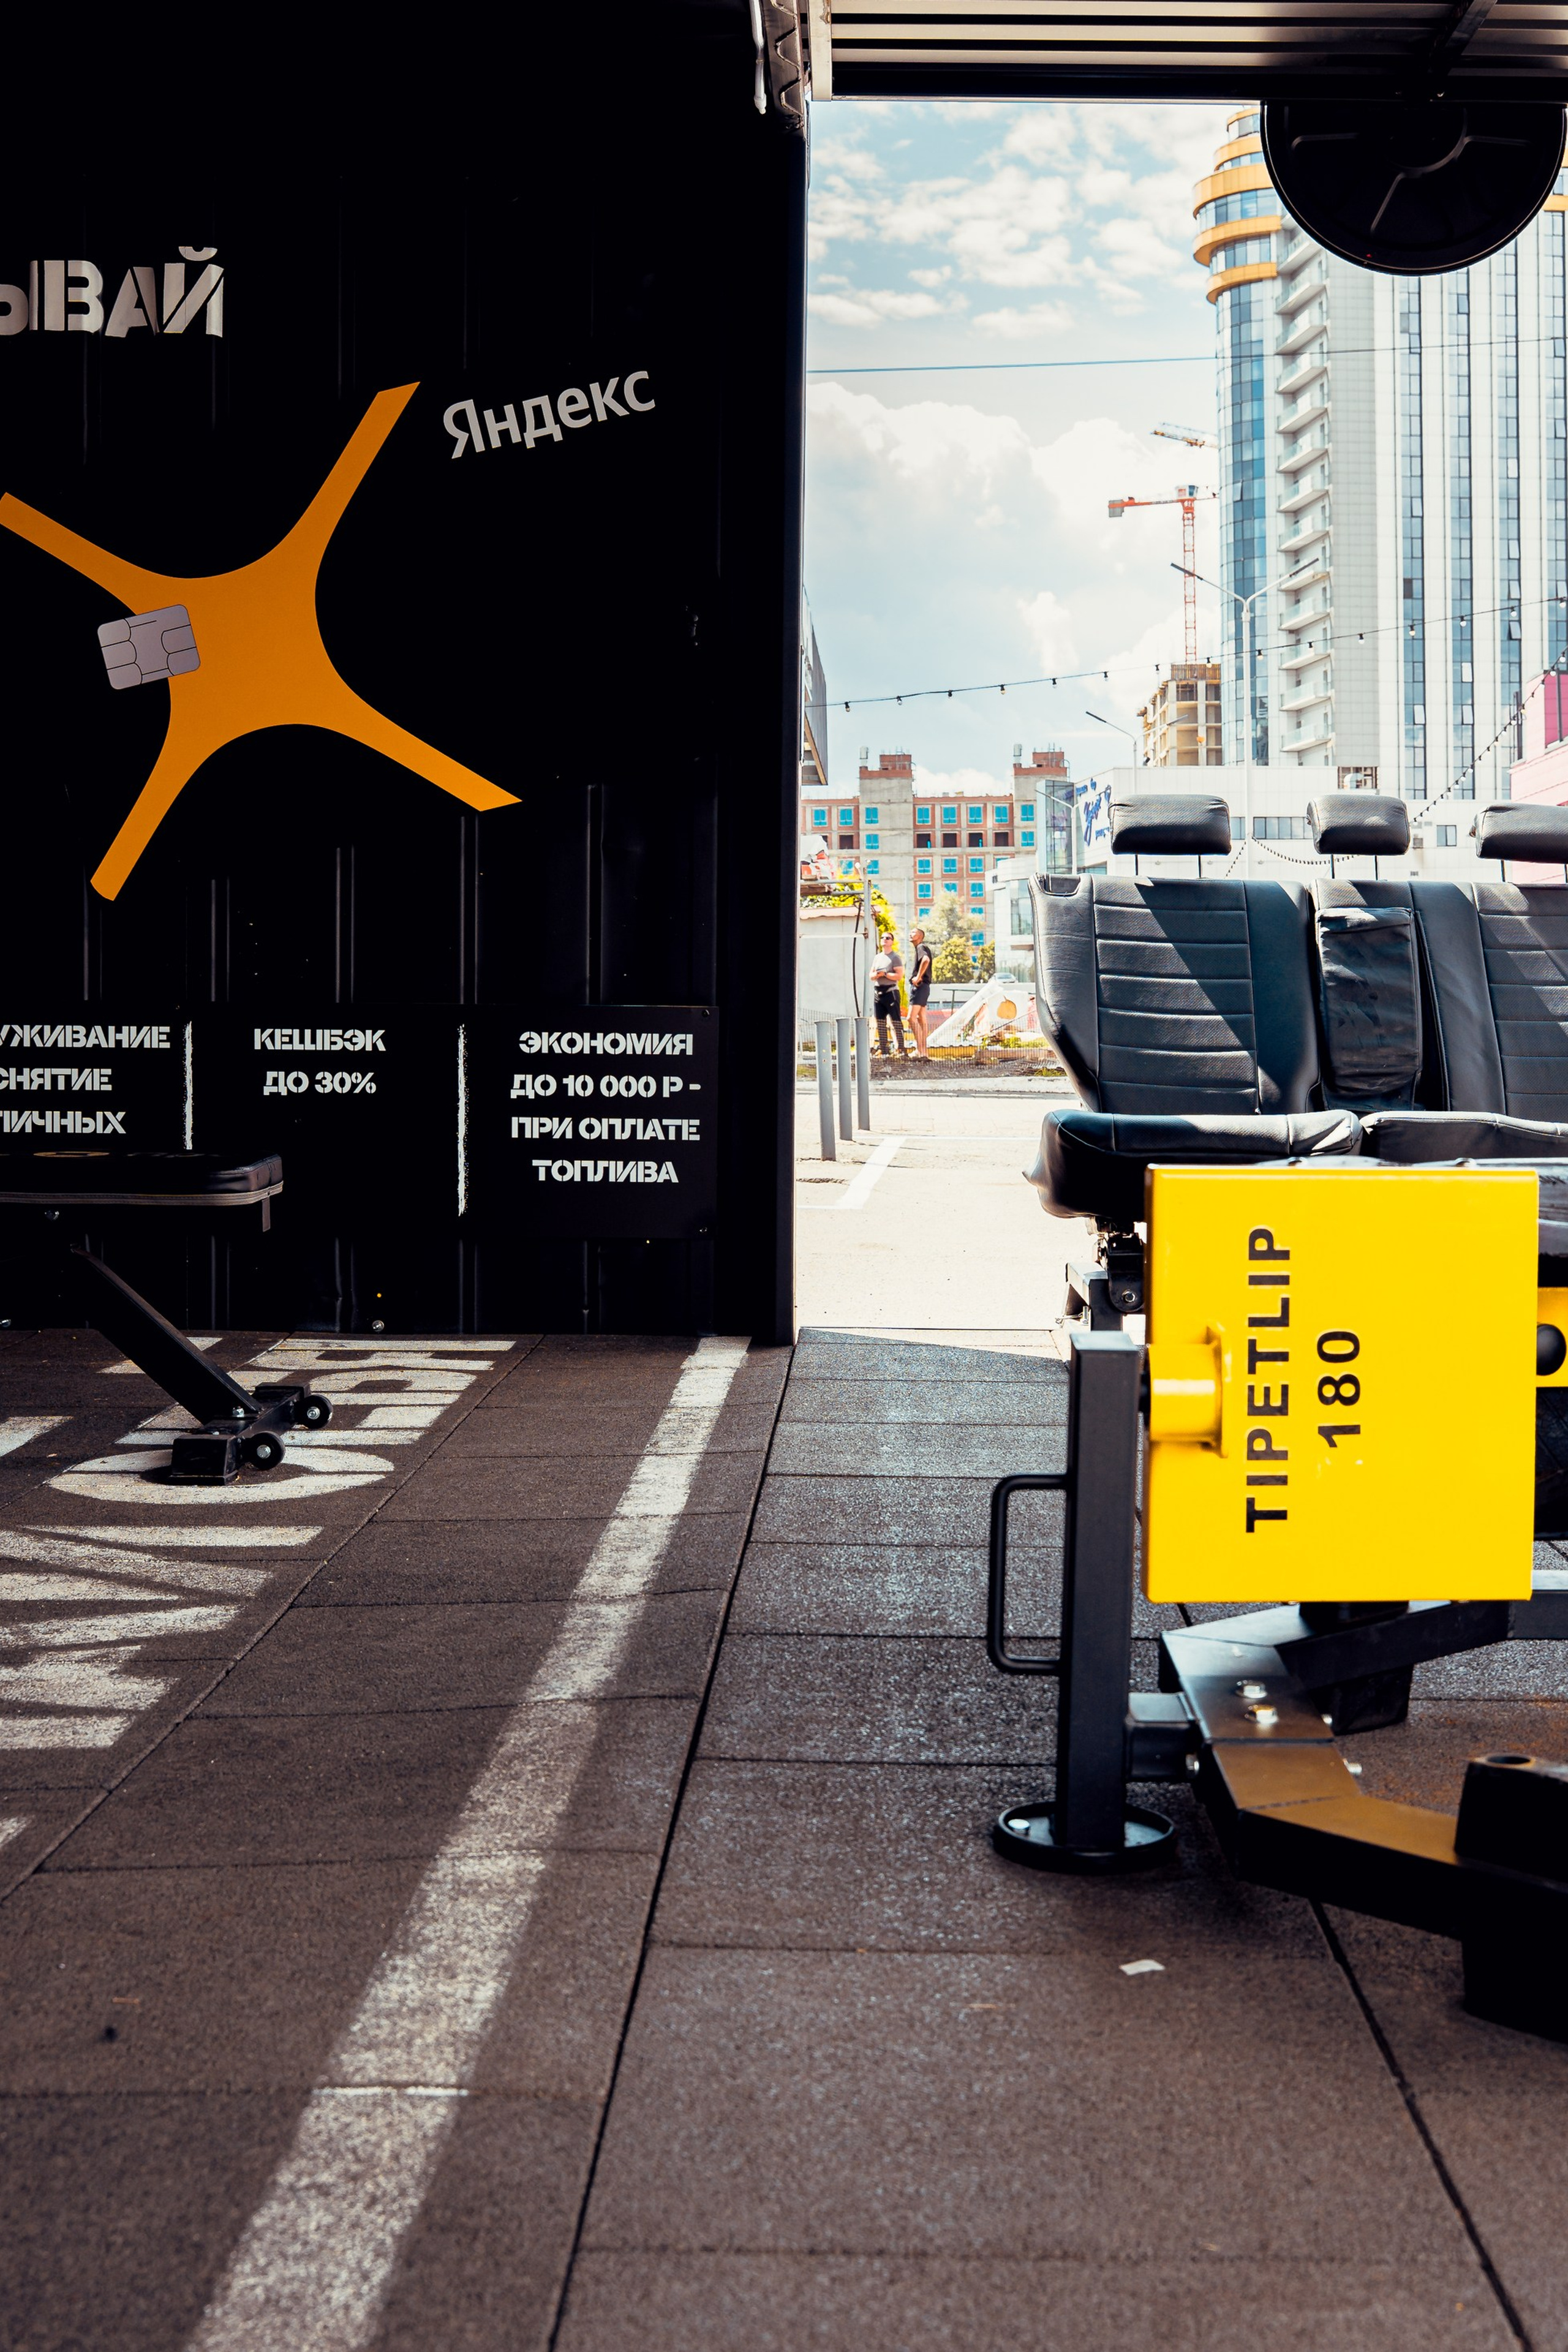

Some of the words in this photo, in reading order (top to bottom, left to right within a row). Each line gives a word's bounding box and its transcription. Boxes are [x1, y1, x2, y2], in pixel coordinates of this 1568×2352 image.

[0, 246, 224, 337] ЫВАЙ
[443, 371, 655, 459] Яндекс
[254, 1028, 386, 1052] КЕШБЭК
[519, 1031, 693, 1055] ЭКОНОМИЯ
[263, 1071, 309, 1096] ДО
[314, 1071, 377, 1093] 30%
[510, 1074, 557, 1099] ДО
[562, 1074, 594, 1097] 10
[600, 1075, 657, 1098] 000
[511, 1117, 573, 1139] ПРИ
[578, 1117, 700, 1141] ОПЛАТЕ
[532, 1159, 679, 1183] ТОПЛИВА
[1246, 1229, 1290, 1533] TIPETLIP
[1317, 1331, 1360, 1448] 180
